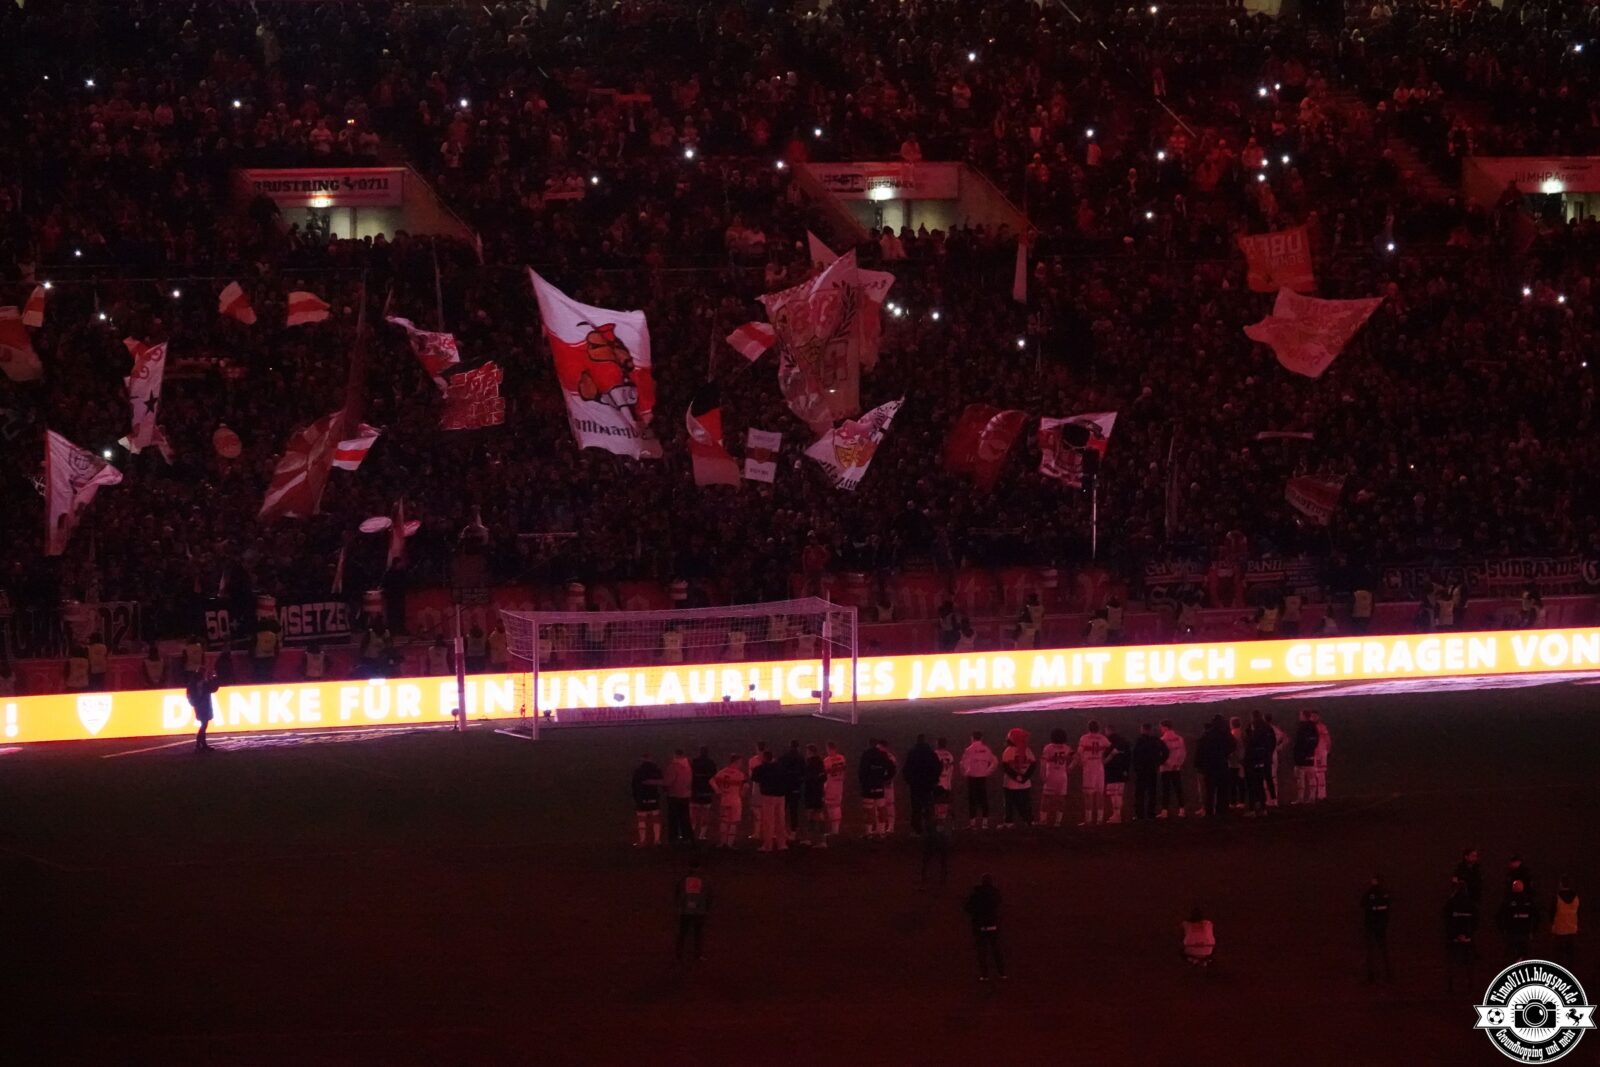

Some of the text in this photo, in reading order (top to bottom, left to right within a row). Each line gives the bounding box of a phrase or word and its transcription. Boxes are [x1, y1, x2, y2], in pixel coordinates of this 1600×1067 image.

[4, 702, 18, 737] !
[340, 678, 422, 721] FÜR
[439, 678, 516, 716] EIN
[537, 659, 897, 710] UNGLAUBLICHES
[907, 655, 1017, 700] JAHR
[1030, 652, 1111, 688] MIT
[1124, 647, 1238, 684] EUCH
[1284, 635, 1498, 677] GETRAGEN
[1510, 632, 1600, 668] VON
